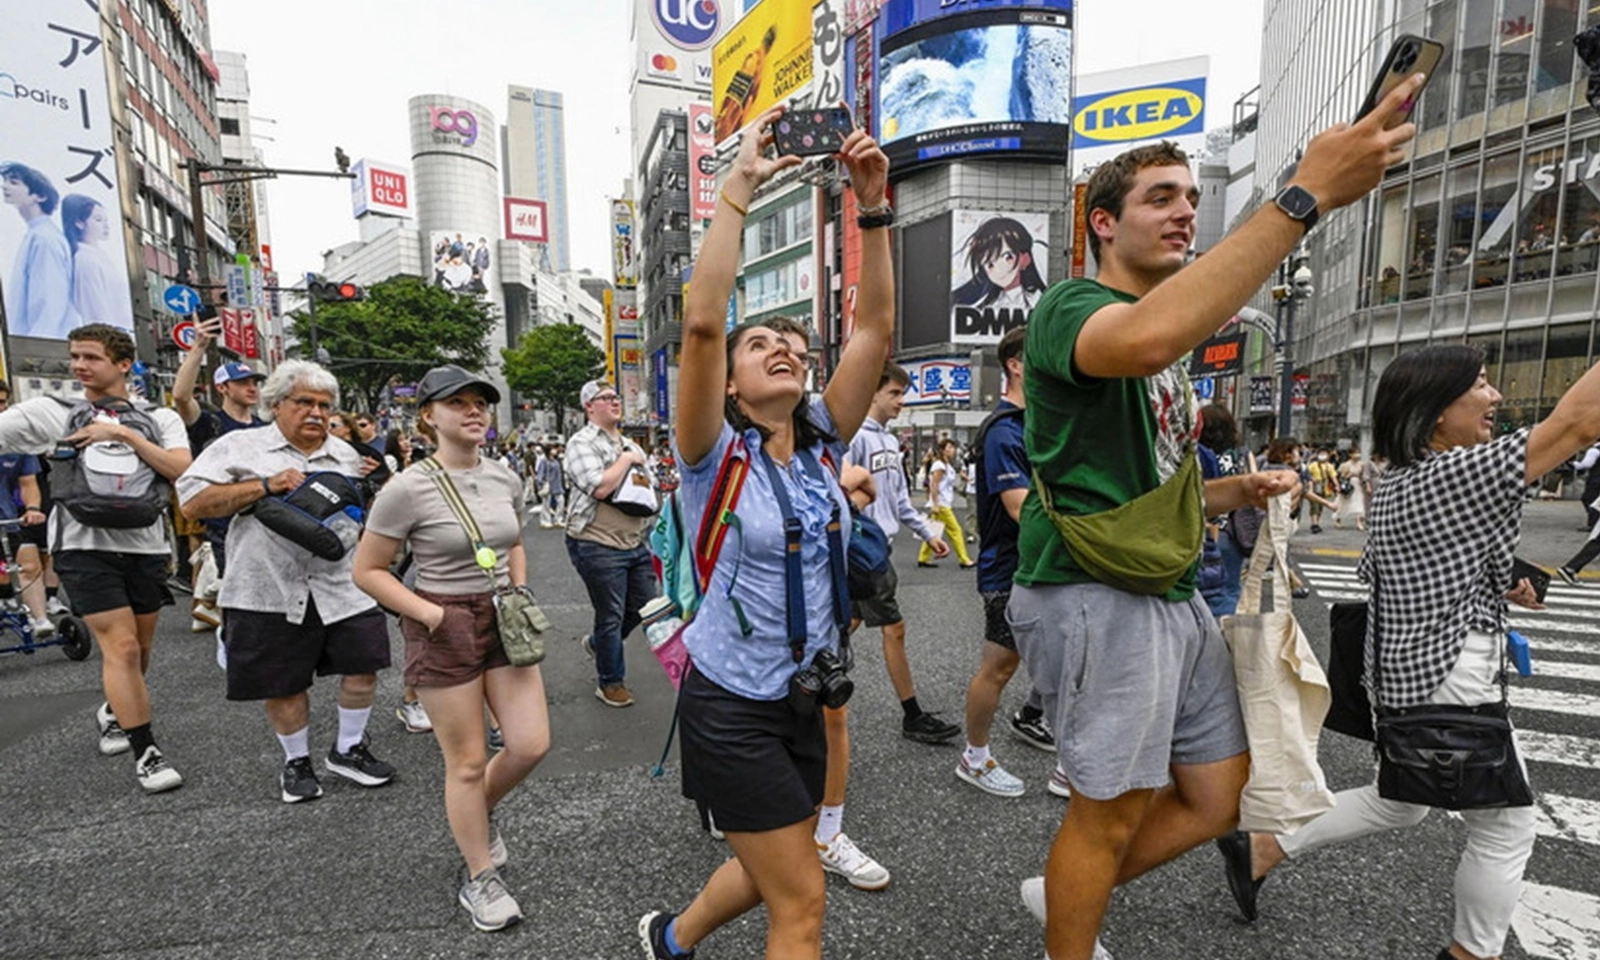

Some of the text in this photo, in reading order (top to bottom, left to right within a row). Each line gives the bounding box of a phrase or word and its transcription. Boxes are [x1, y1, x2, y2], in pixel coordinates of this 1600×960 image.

[14, 83, 70, 111] pairs
[47, 0, 115, 190] アーズ
[1084, 97, 1193, 131] IKEA
[374, 172, 401, 191] UNI
[375, 187, 404, 204] QLO
